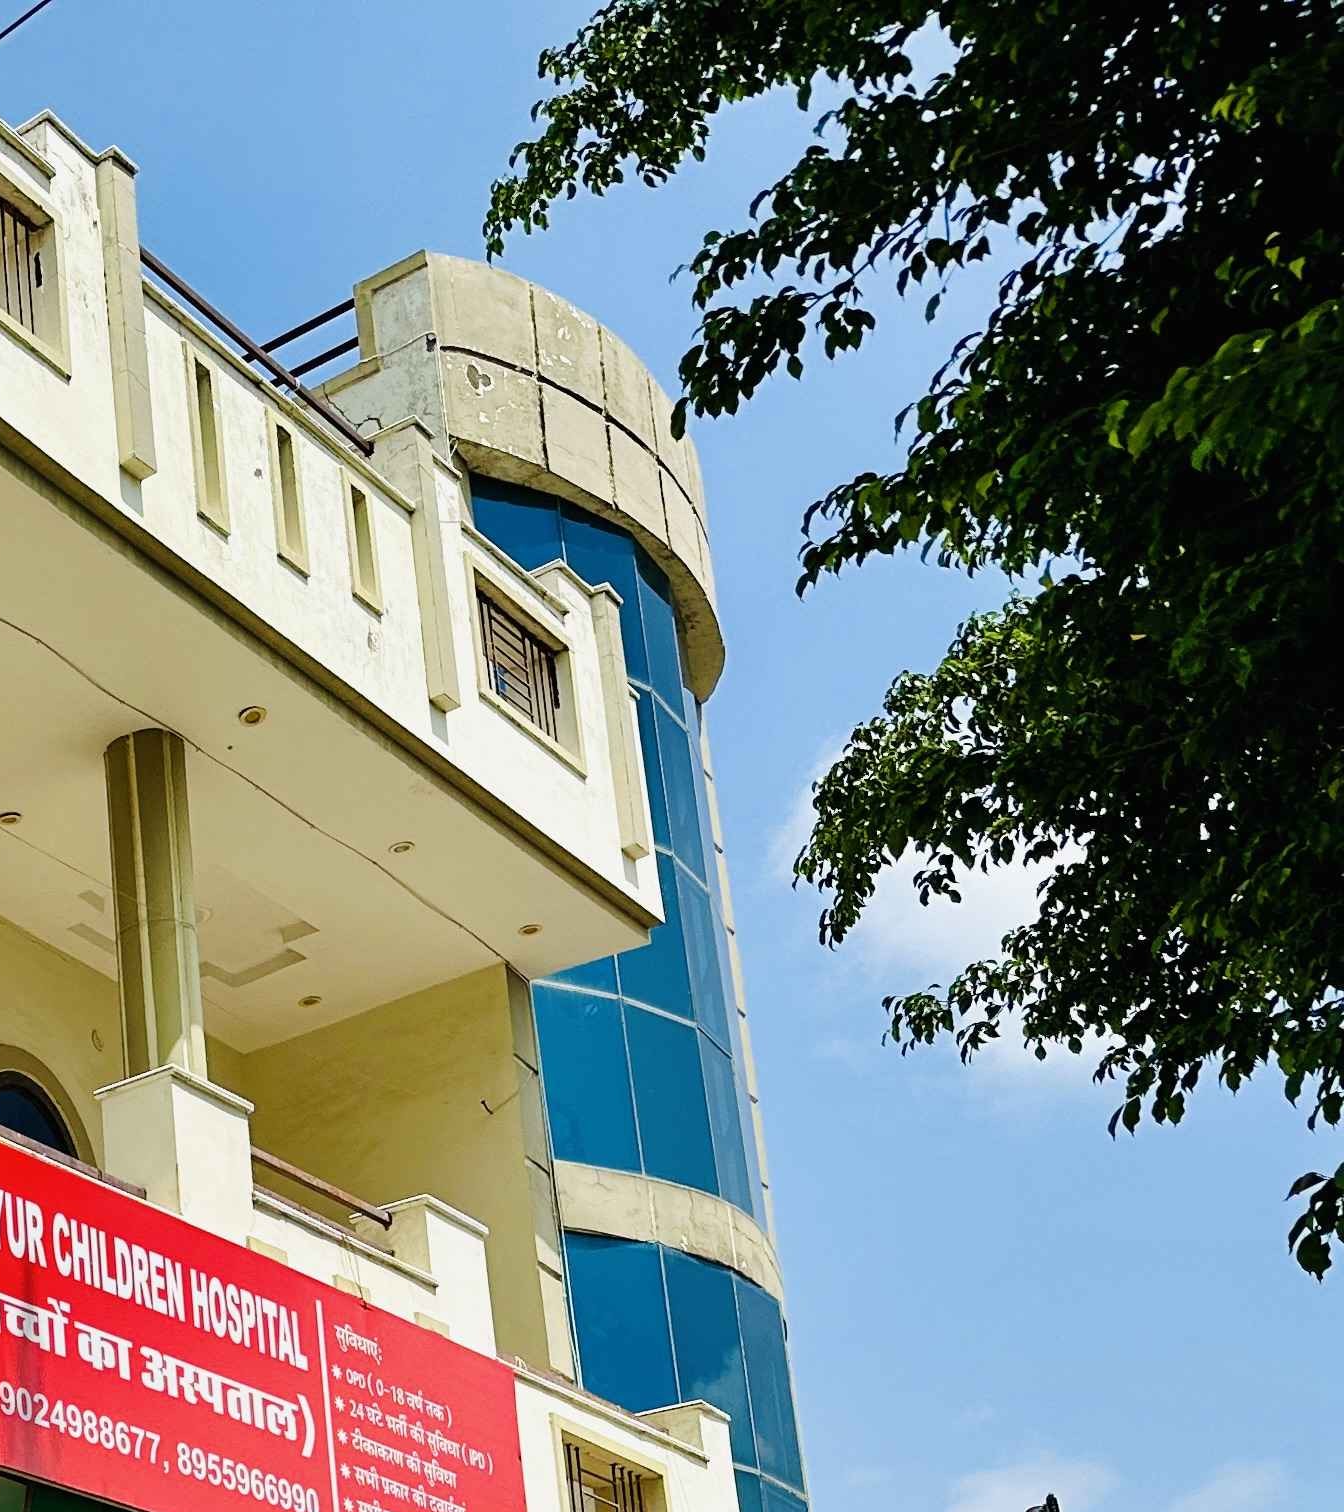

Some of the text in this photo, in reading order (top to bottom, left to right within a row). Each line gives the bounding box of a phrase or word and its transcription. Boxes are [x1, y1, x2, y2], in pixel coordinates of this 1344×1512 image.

[53, 1212, 186, 1323] CHILDREN
[190, 1268, 309, 1371] HOSPITAL
[74, 1321, 133, 1381] का
[348, 1399, 364, 1421] 24
[409, 1421, 425, 1446] की
[425, 1430, 461, 1458] सुविधा
[353, 1466, 379, 1491] सभी
[381, 1477, 410, 1504] प्रकार
[411, 1485, 426, 1510] की
[405, 1451, 421, 1474] की
[422, 1459, 457, 1488] सुविधा
